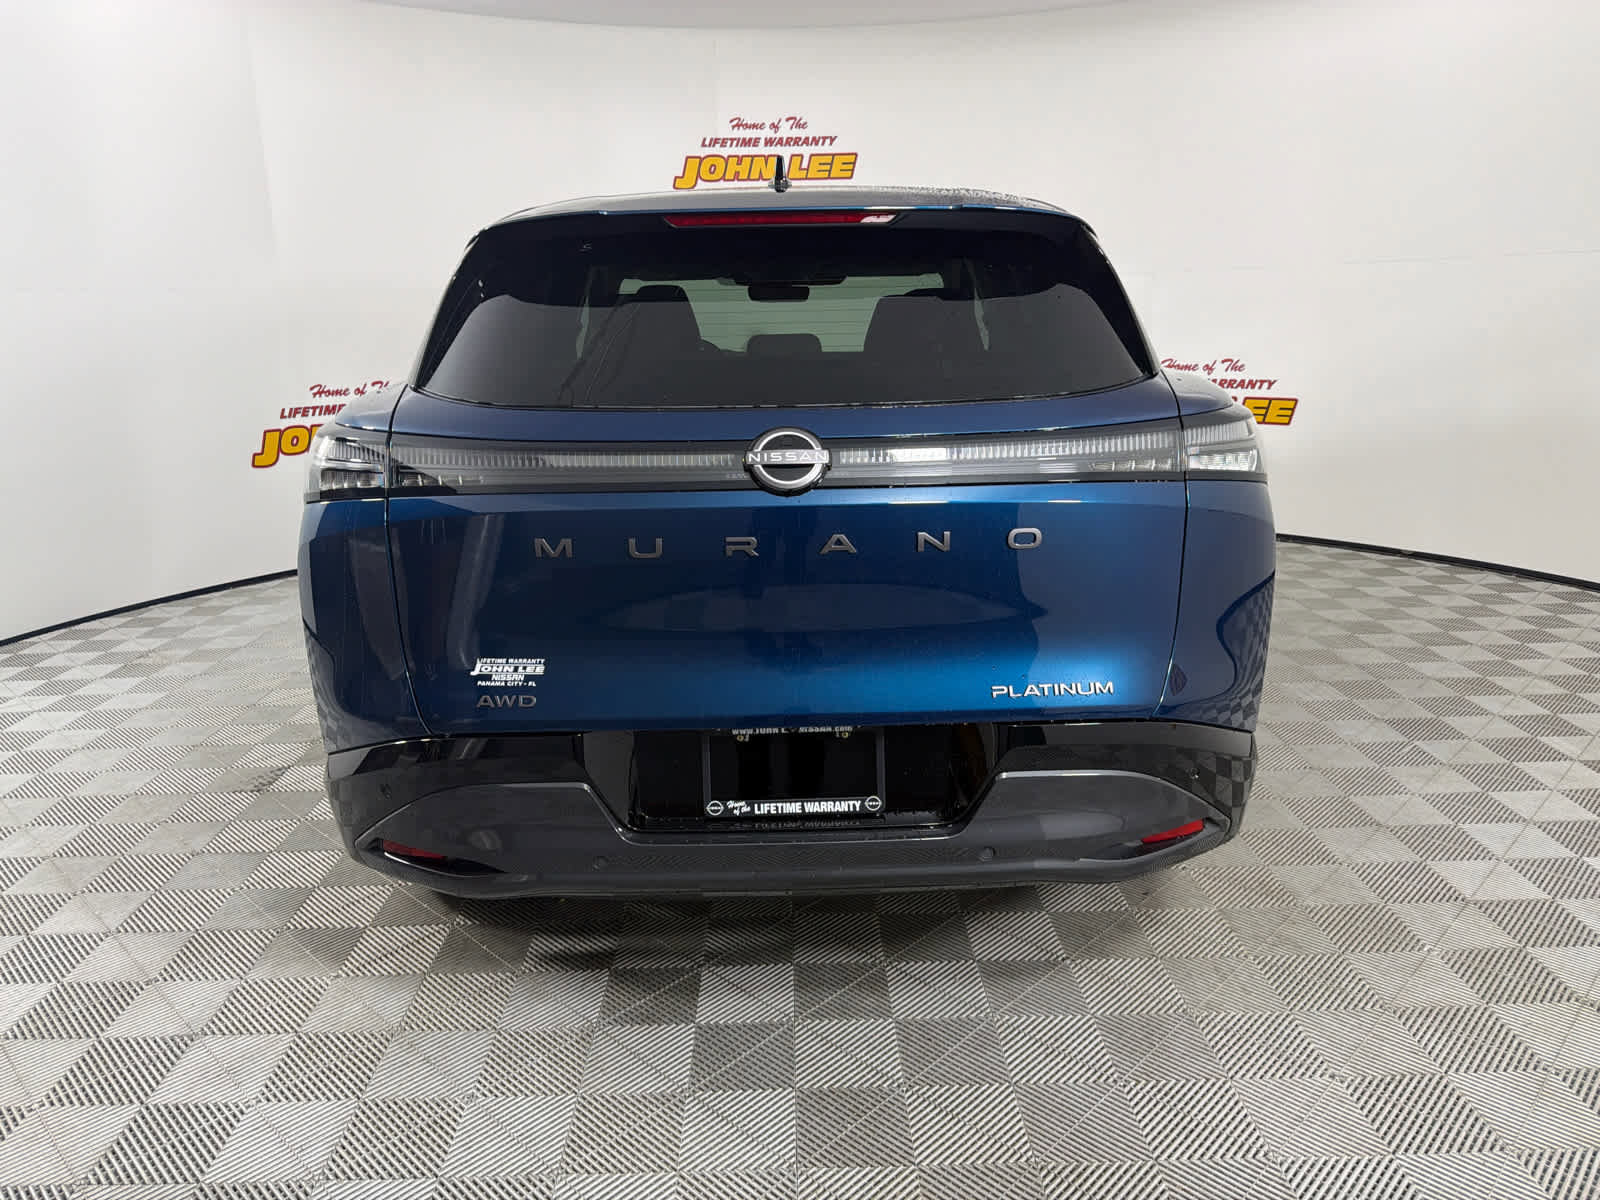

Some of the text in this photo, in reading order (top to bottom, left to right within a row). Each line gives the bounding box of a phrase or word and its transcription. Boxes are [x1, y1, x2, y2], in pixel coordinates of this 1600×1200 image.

[729, 116, 808, 133] Home of The
[701, 135, 838, 148] LIFETIME WARRANTY
[673, 152, 858, 190] JOHN LEE
[1160, 358, 1246, 376] Home of The
[309, 383, 351, 398] Home
[353, 382, 368, 396] of
[747, 451, 827, 463] NISSAN
[534, 527, 1043, 560] MURANO
[491, 673, 525, 681] NISSAN
[518, 665, 545, 674] LEE
[991, 681, 1115, 698] PLATINUM
[476, 695, 537, 708] AWD
[754, 800, 862, 815] LIFETIME WARRANTY
